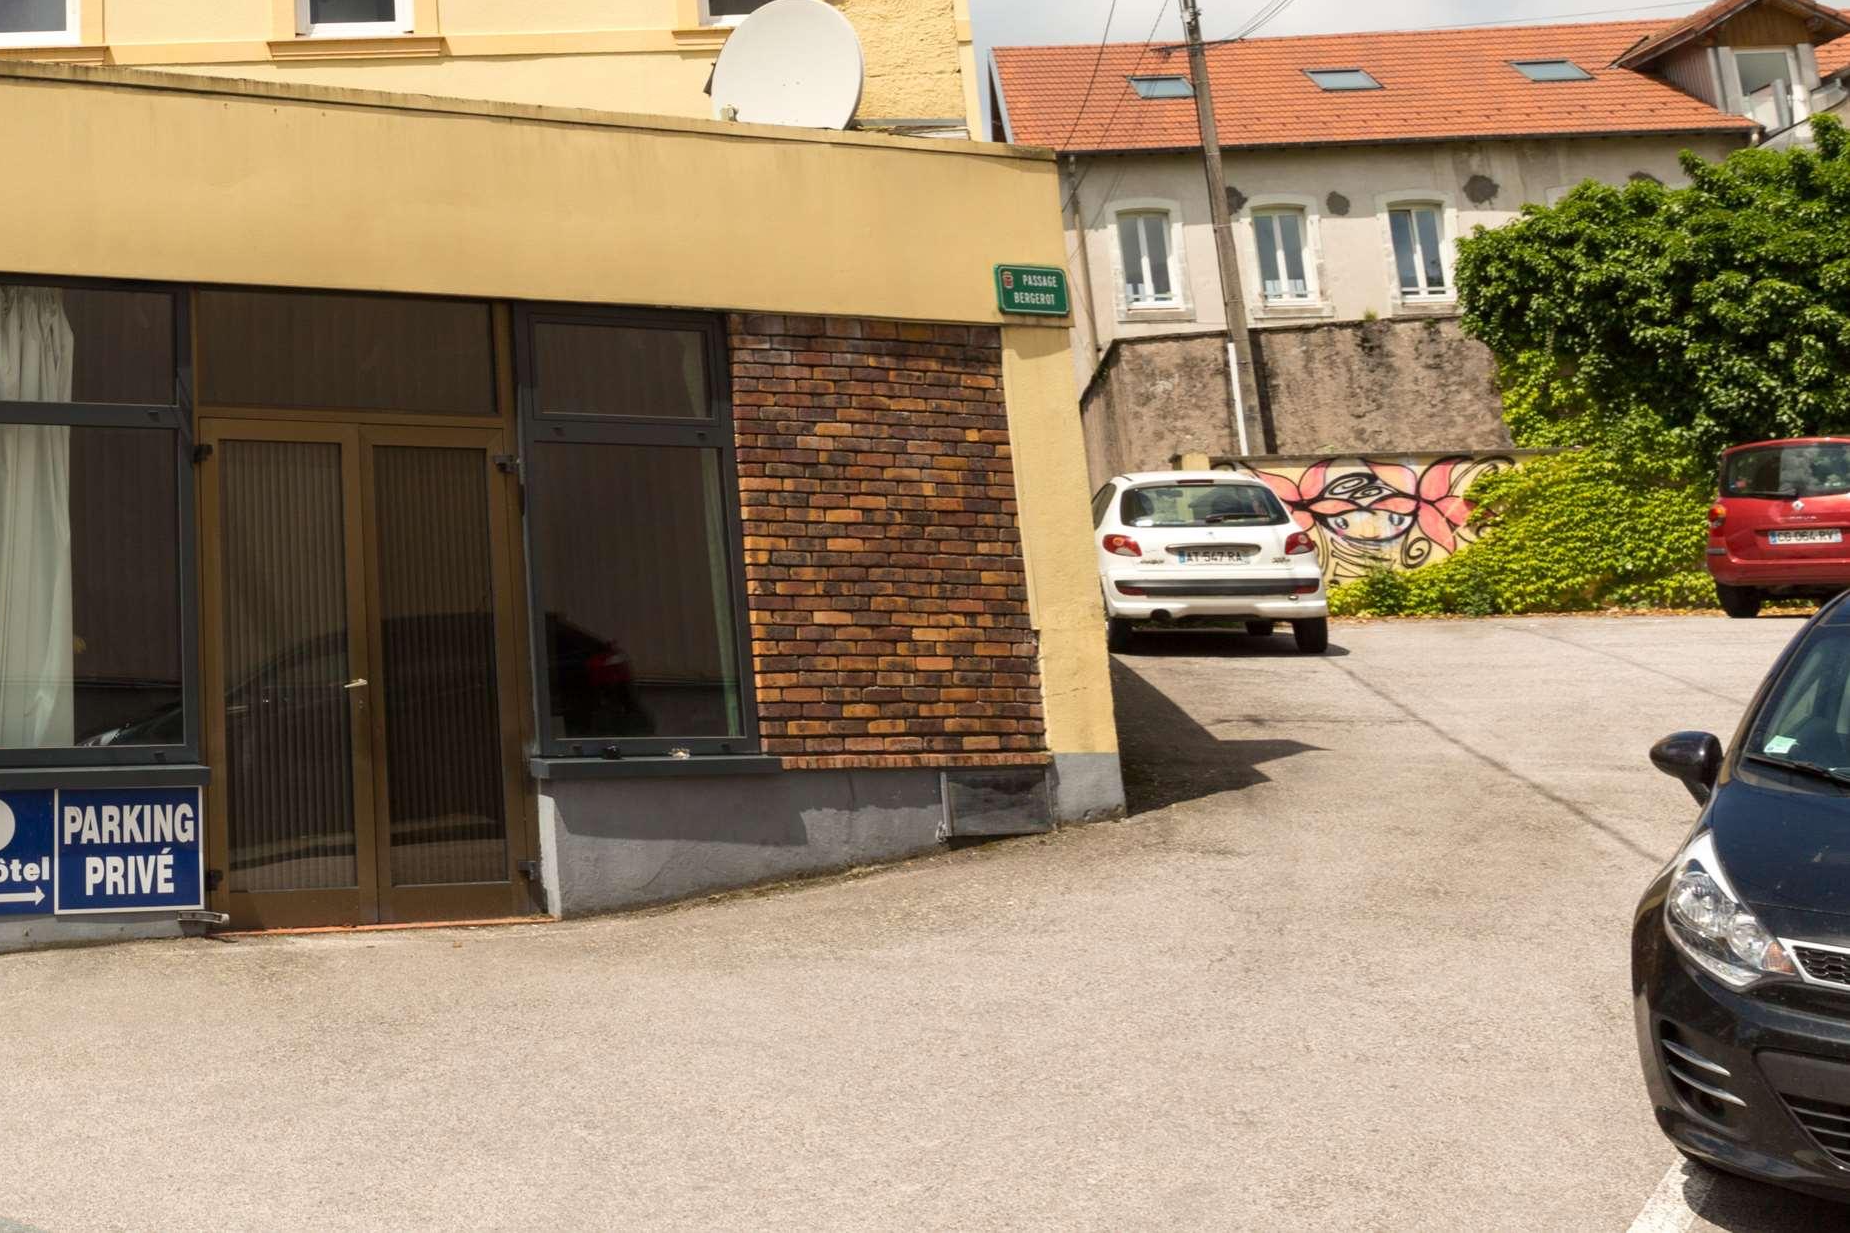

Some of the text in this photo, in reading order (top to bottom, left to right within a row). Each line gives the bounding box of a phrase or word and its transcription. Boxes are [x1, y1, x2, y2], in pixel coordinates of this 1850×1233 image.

[1022, 274, 1058, 288] PASSAGE
[1013, 292, 1055, 305] BERGEROT
[64, 803, 194, 845] PARKING
[85, 847, 174, 896] PRIVÉ
